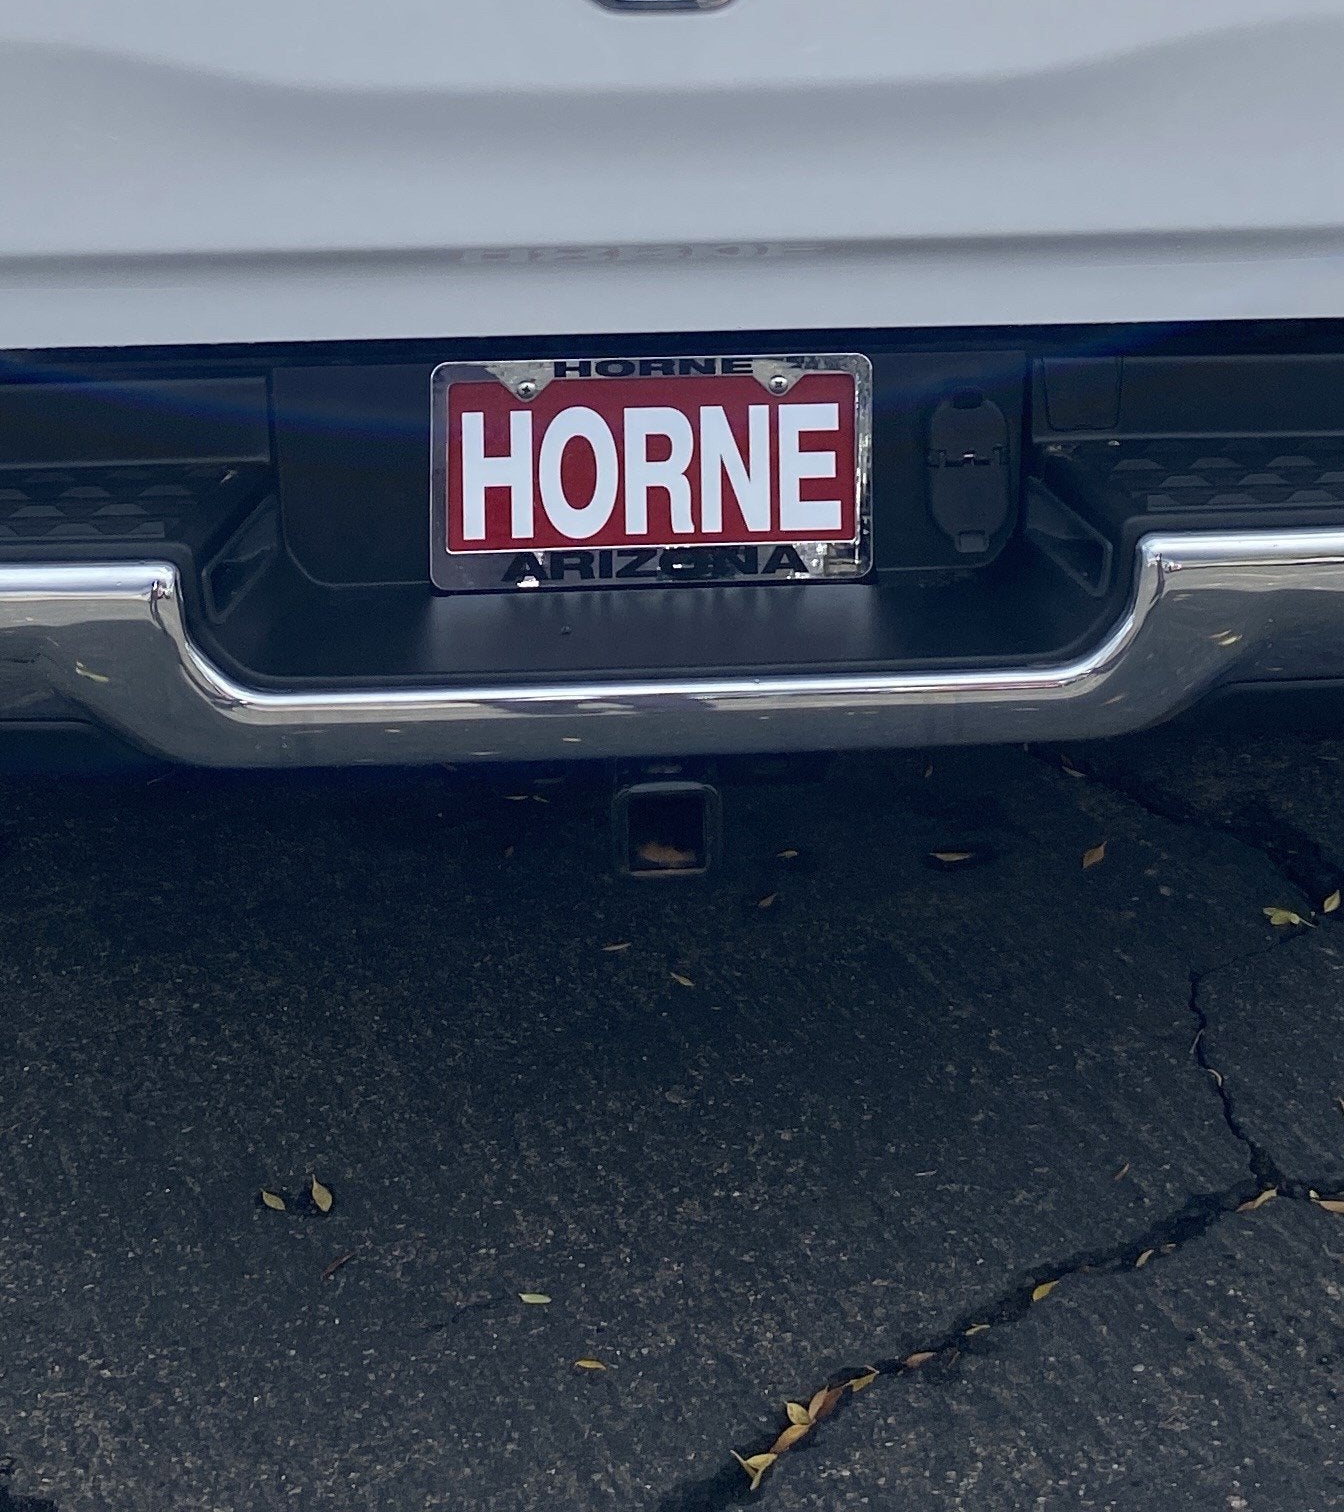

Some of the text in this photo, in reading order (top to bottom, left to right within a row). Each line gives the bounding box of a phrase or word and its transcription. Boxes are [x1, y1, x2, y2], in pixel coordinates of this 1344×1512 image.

[554, 357, 754, 378] HORNE
[461, 402, 843, 541] HORNE
[501, 546, 809, 582] ARIZONA
